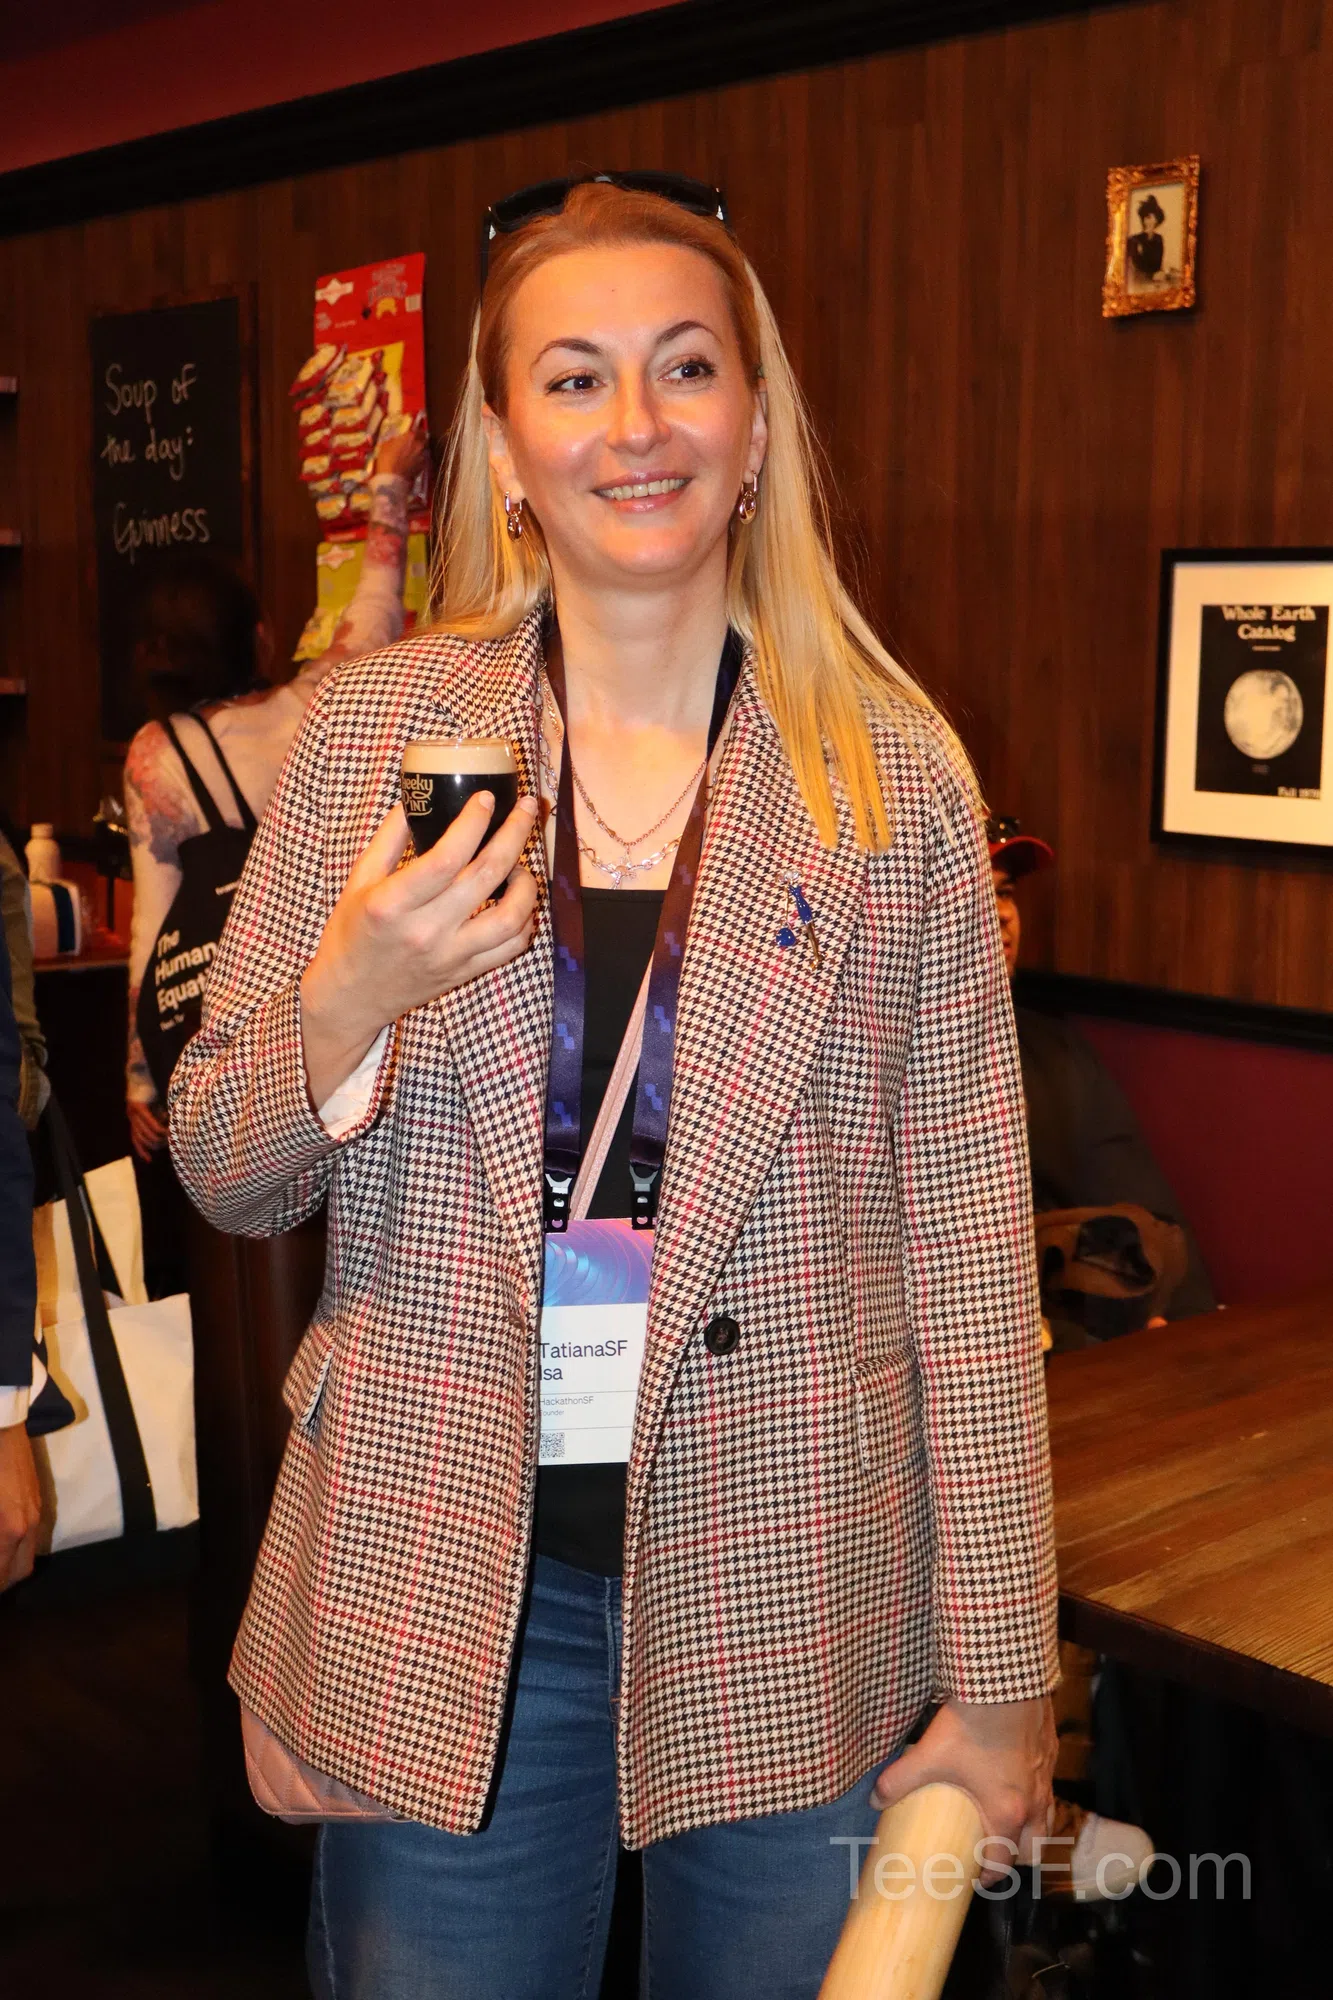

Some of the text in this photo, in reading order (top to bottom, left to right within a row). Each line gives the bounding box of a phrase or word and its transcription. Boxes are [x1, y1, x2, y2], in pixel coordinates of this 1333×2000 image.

[105, 363, 196, 424] Soup of
[100, 427, 193, 480] the day:
[1222, 605, 1316, 621] Whole Earth
[1238, 623, 1296, 642] Catalog
[157, 930, 180, 958] The
[155, 941, 217, 986] Human
[539, 1340, 628, 1359] TatianaSF
